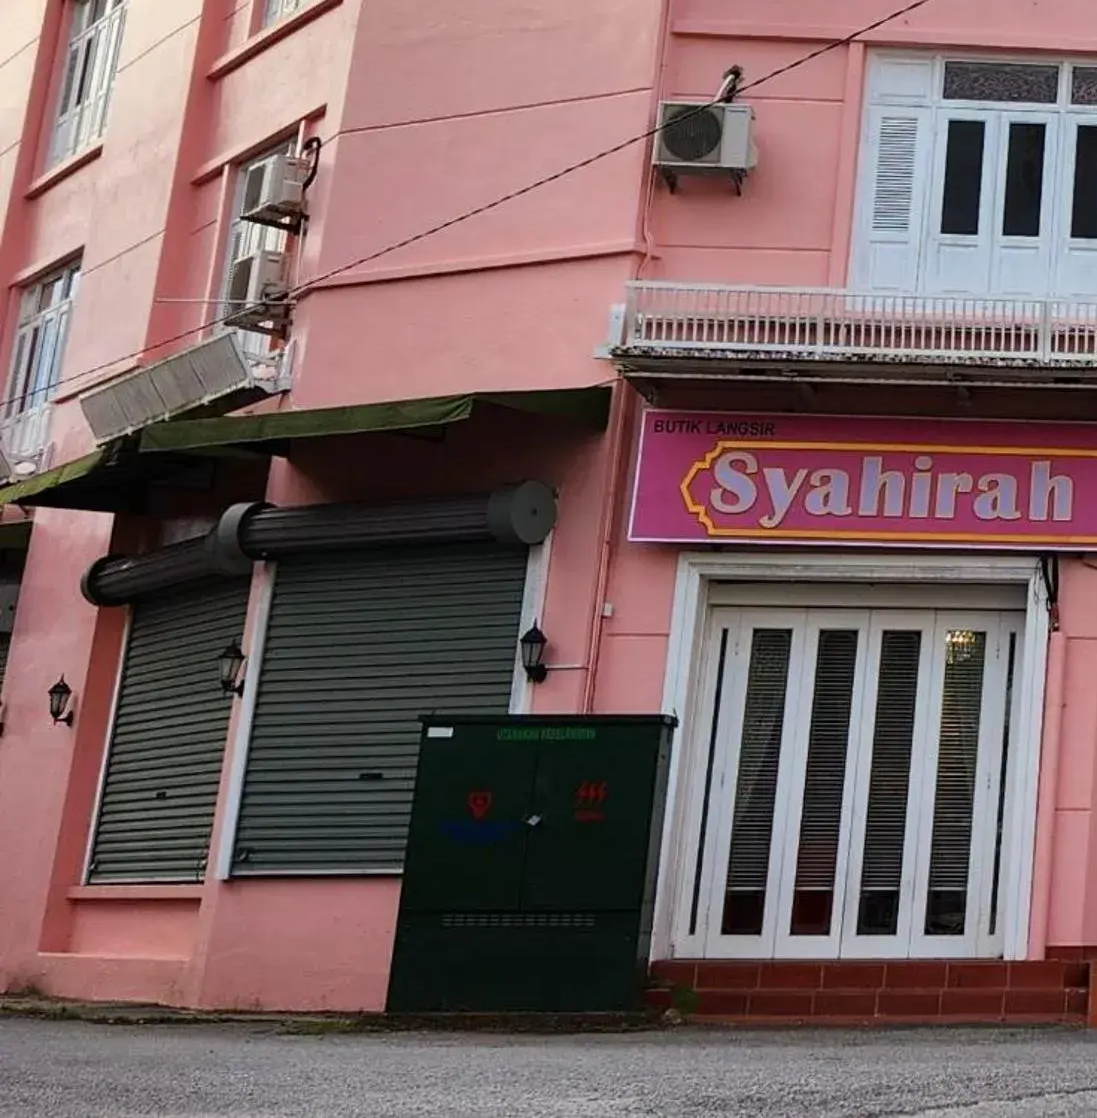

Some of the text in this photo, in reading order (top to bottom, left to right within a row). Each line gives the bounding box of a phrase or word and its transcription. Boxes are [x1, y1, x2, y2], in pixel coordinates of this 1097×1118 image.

[653, 419, 776, 436] BUTIK LANGSIR
[709, 451, 1075, 529] Syahirah
